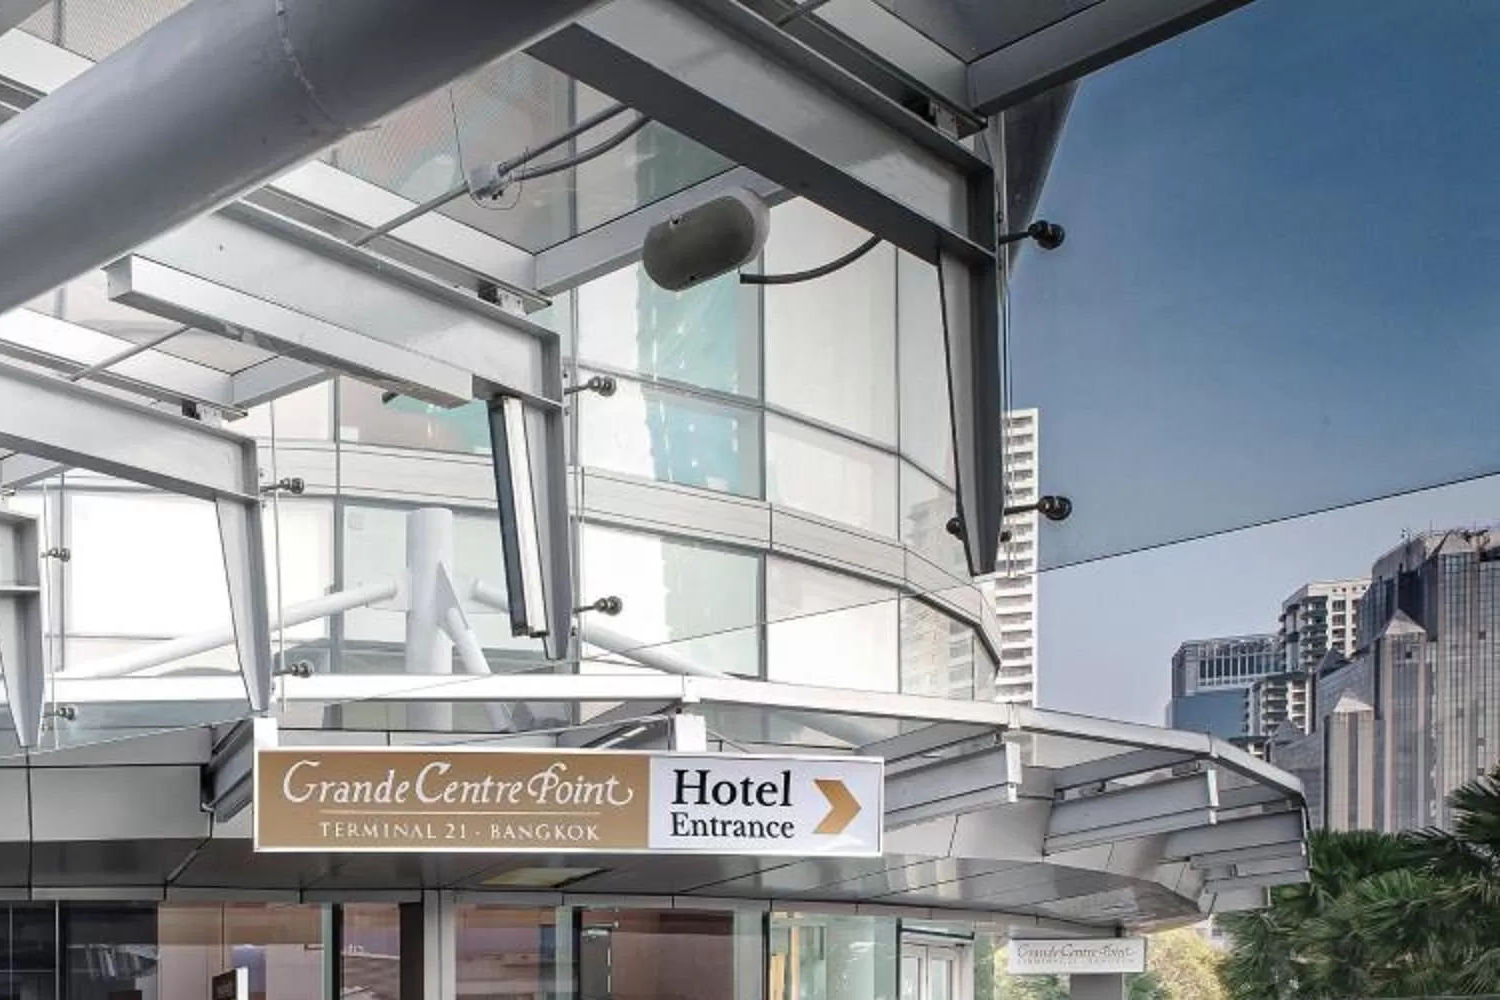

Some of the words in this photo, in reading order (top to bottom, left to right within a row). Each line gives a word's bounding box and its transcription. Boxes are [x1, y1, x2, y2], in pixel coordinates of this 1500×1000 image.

[282, 760, 411, 803] Grande
[415, 761, 527, 804] Centre
[527, 763, 634, 806] Point
[671, 769, 792, 806] Hotel
[319, 822, 437, 840] TERMINAL
[445, 823, 467, 840] 21
[490, 824, 600, 841] BANGKOK
[669, 811, 795, 838] Entrance
